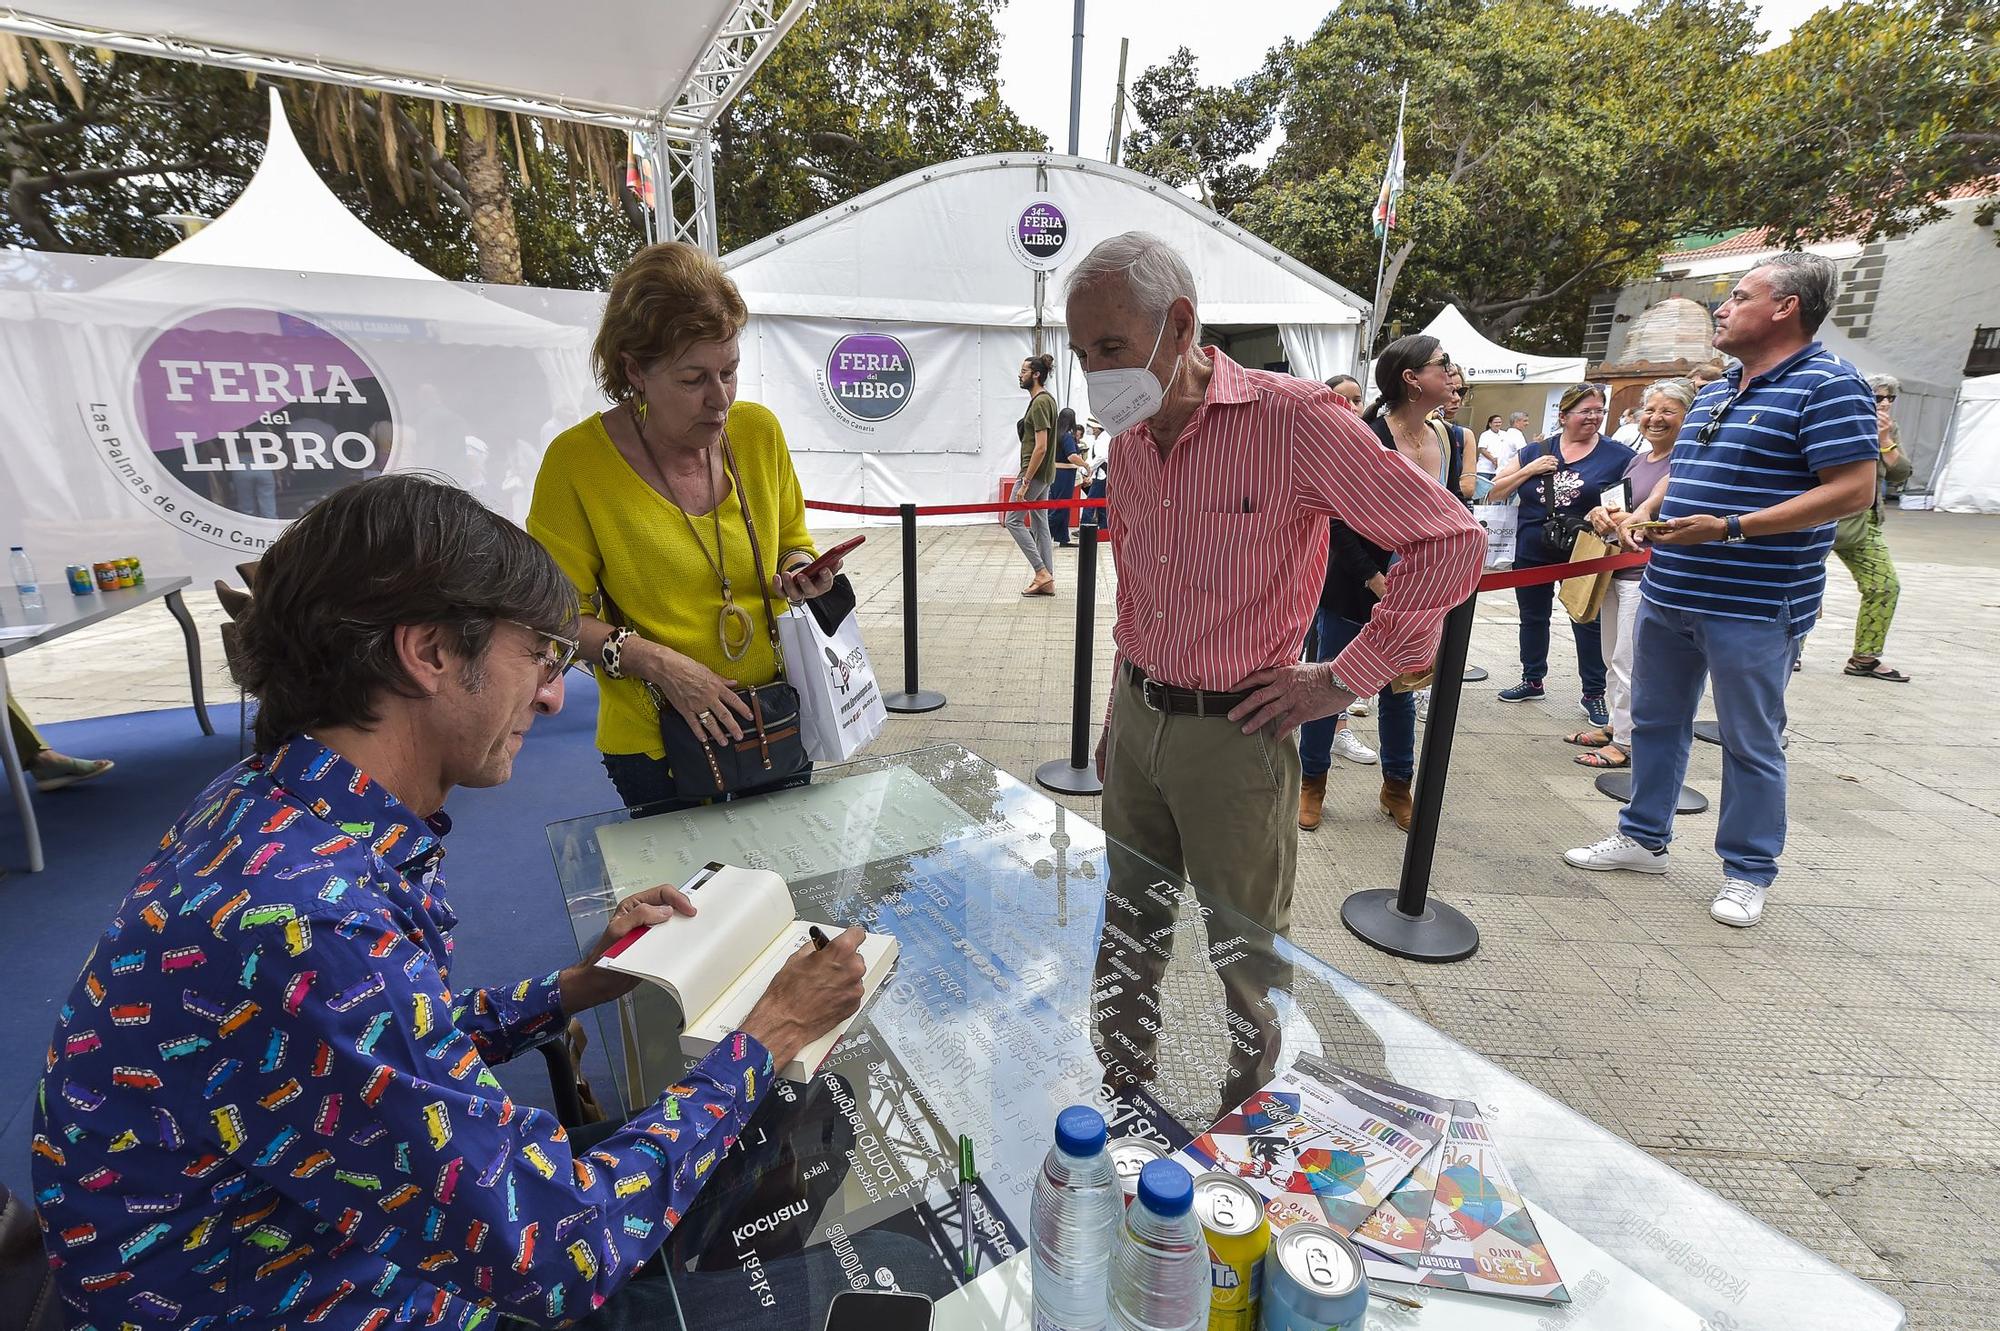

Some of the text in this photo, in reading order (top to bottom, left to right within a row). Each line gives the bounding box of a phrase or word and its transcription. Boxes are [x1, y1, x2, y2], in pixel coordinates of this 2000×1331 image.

[1024, 216, 1063, 228] FERIA
[1024, 234, 1063, 245] LIBRO
[839, 353, 904, 371] FERIA
[159, 359, 367, 404] FERIA
[840, 381, 905, 399] LIBRO
[819, 381, 830, 405] Palmas
[829, 405, 837, 414] de
[836, 412, 850, 425] Gran
[850, 421, 875, 433] Canaria
[260, 411, 291, 425] del
[175, 431, 376, 472] LIBRO
[89, 402, 110, 433] Las
[103, 437, 153, 495] Palmas
[153, 494, 176, 514] de
[179, 509, 224, 539] Gran
[1288, 1202, 1319, 1223] MAYO
[1368, 1208, 1397, 1223] MAY
[1380, 1222, 1405, 1241] 25
[1487, 1247, 1522, 1260] MAYO
[1479, 1256, 1505, 1274] 30
[1515, 1258, 1542, 1277] 25
